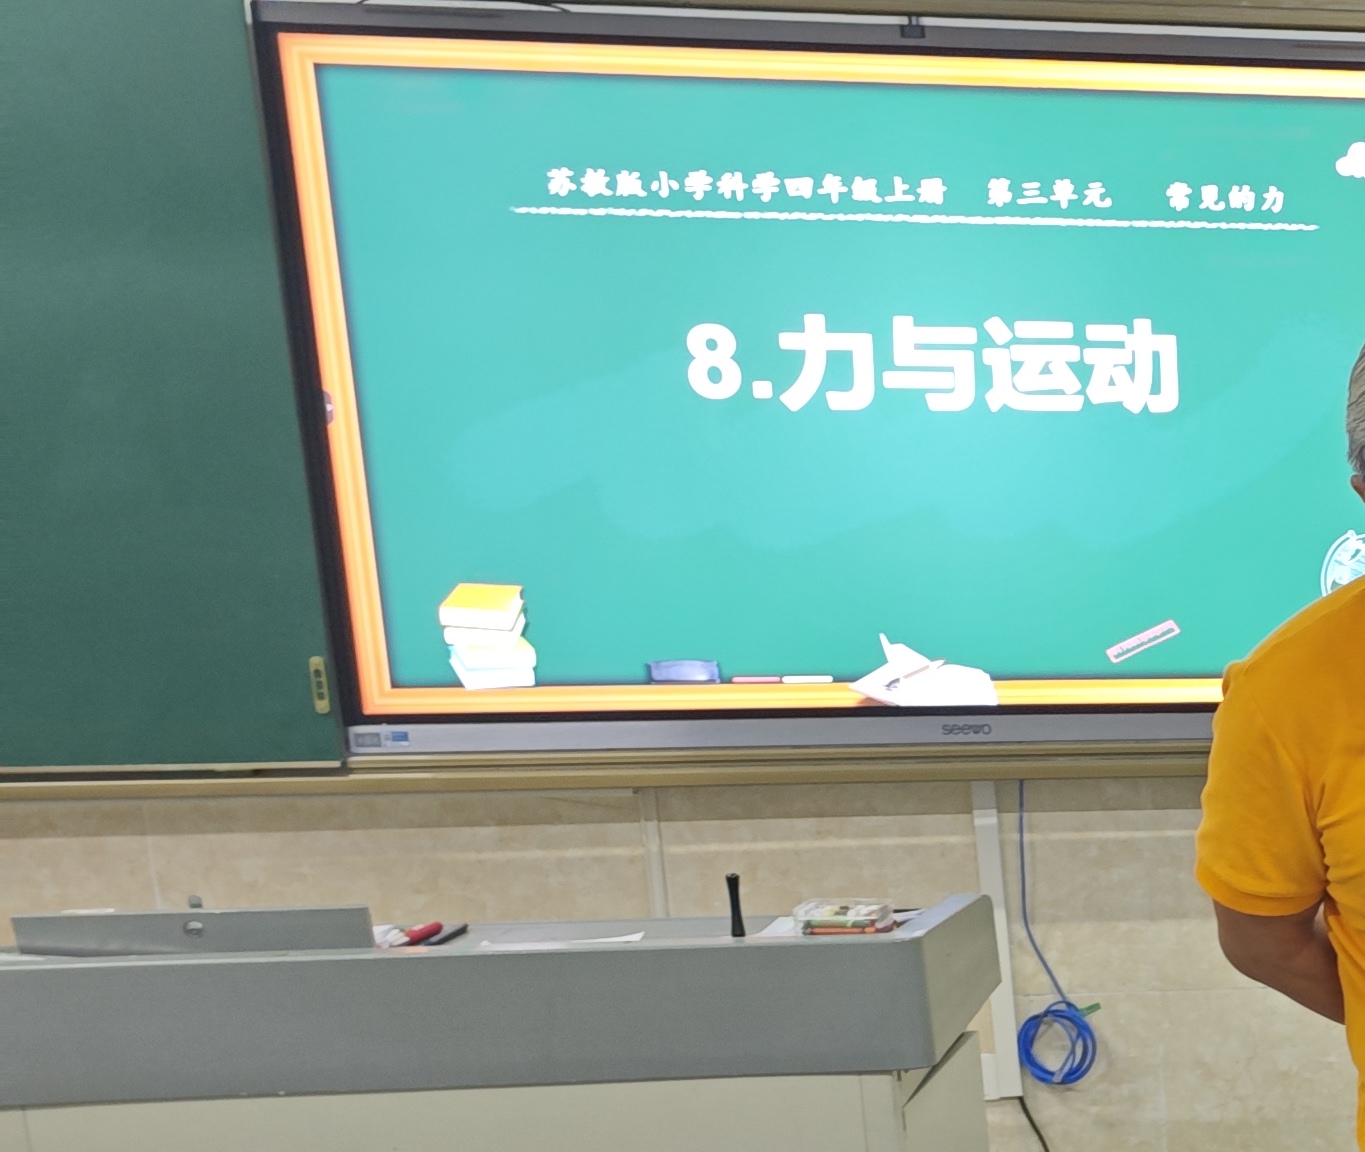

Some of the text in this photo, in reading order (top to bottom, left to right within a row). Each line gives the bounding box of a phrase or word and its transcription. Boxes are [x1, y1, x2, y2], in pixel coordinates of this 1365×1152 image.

[547, 167, 1285, 213] 苏教版小学科学四年级上册 第三单元 常见的力
[686, 313, 1180, 414] 8.力与运动
[941, 723, 992, 735] seewo
